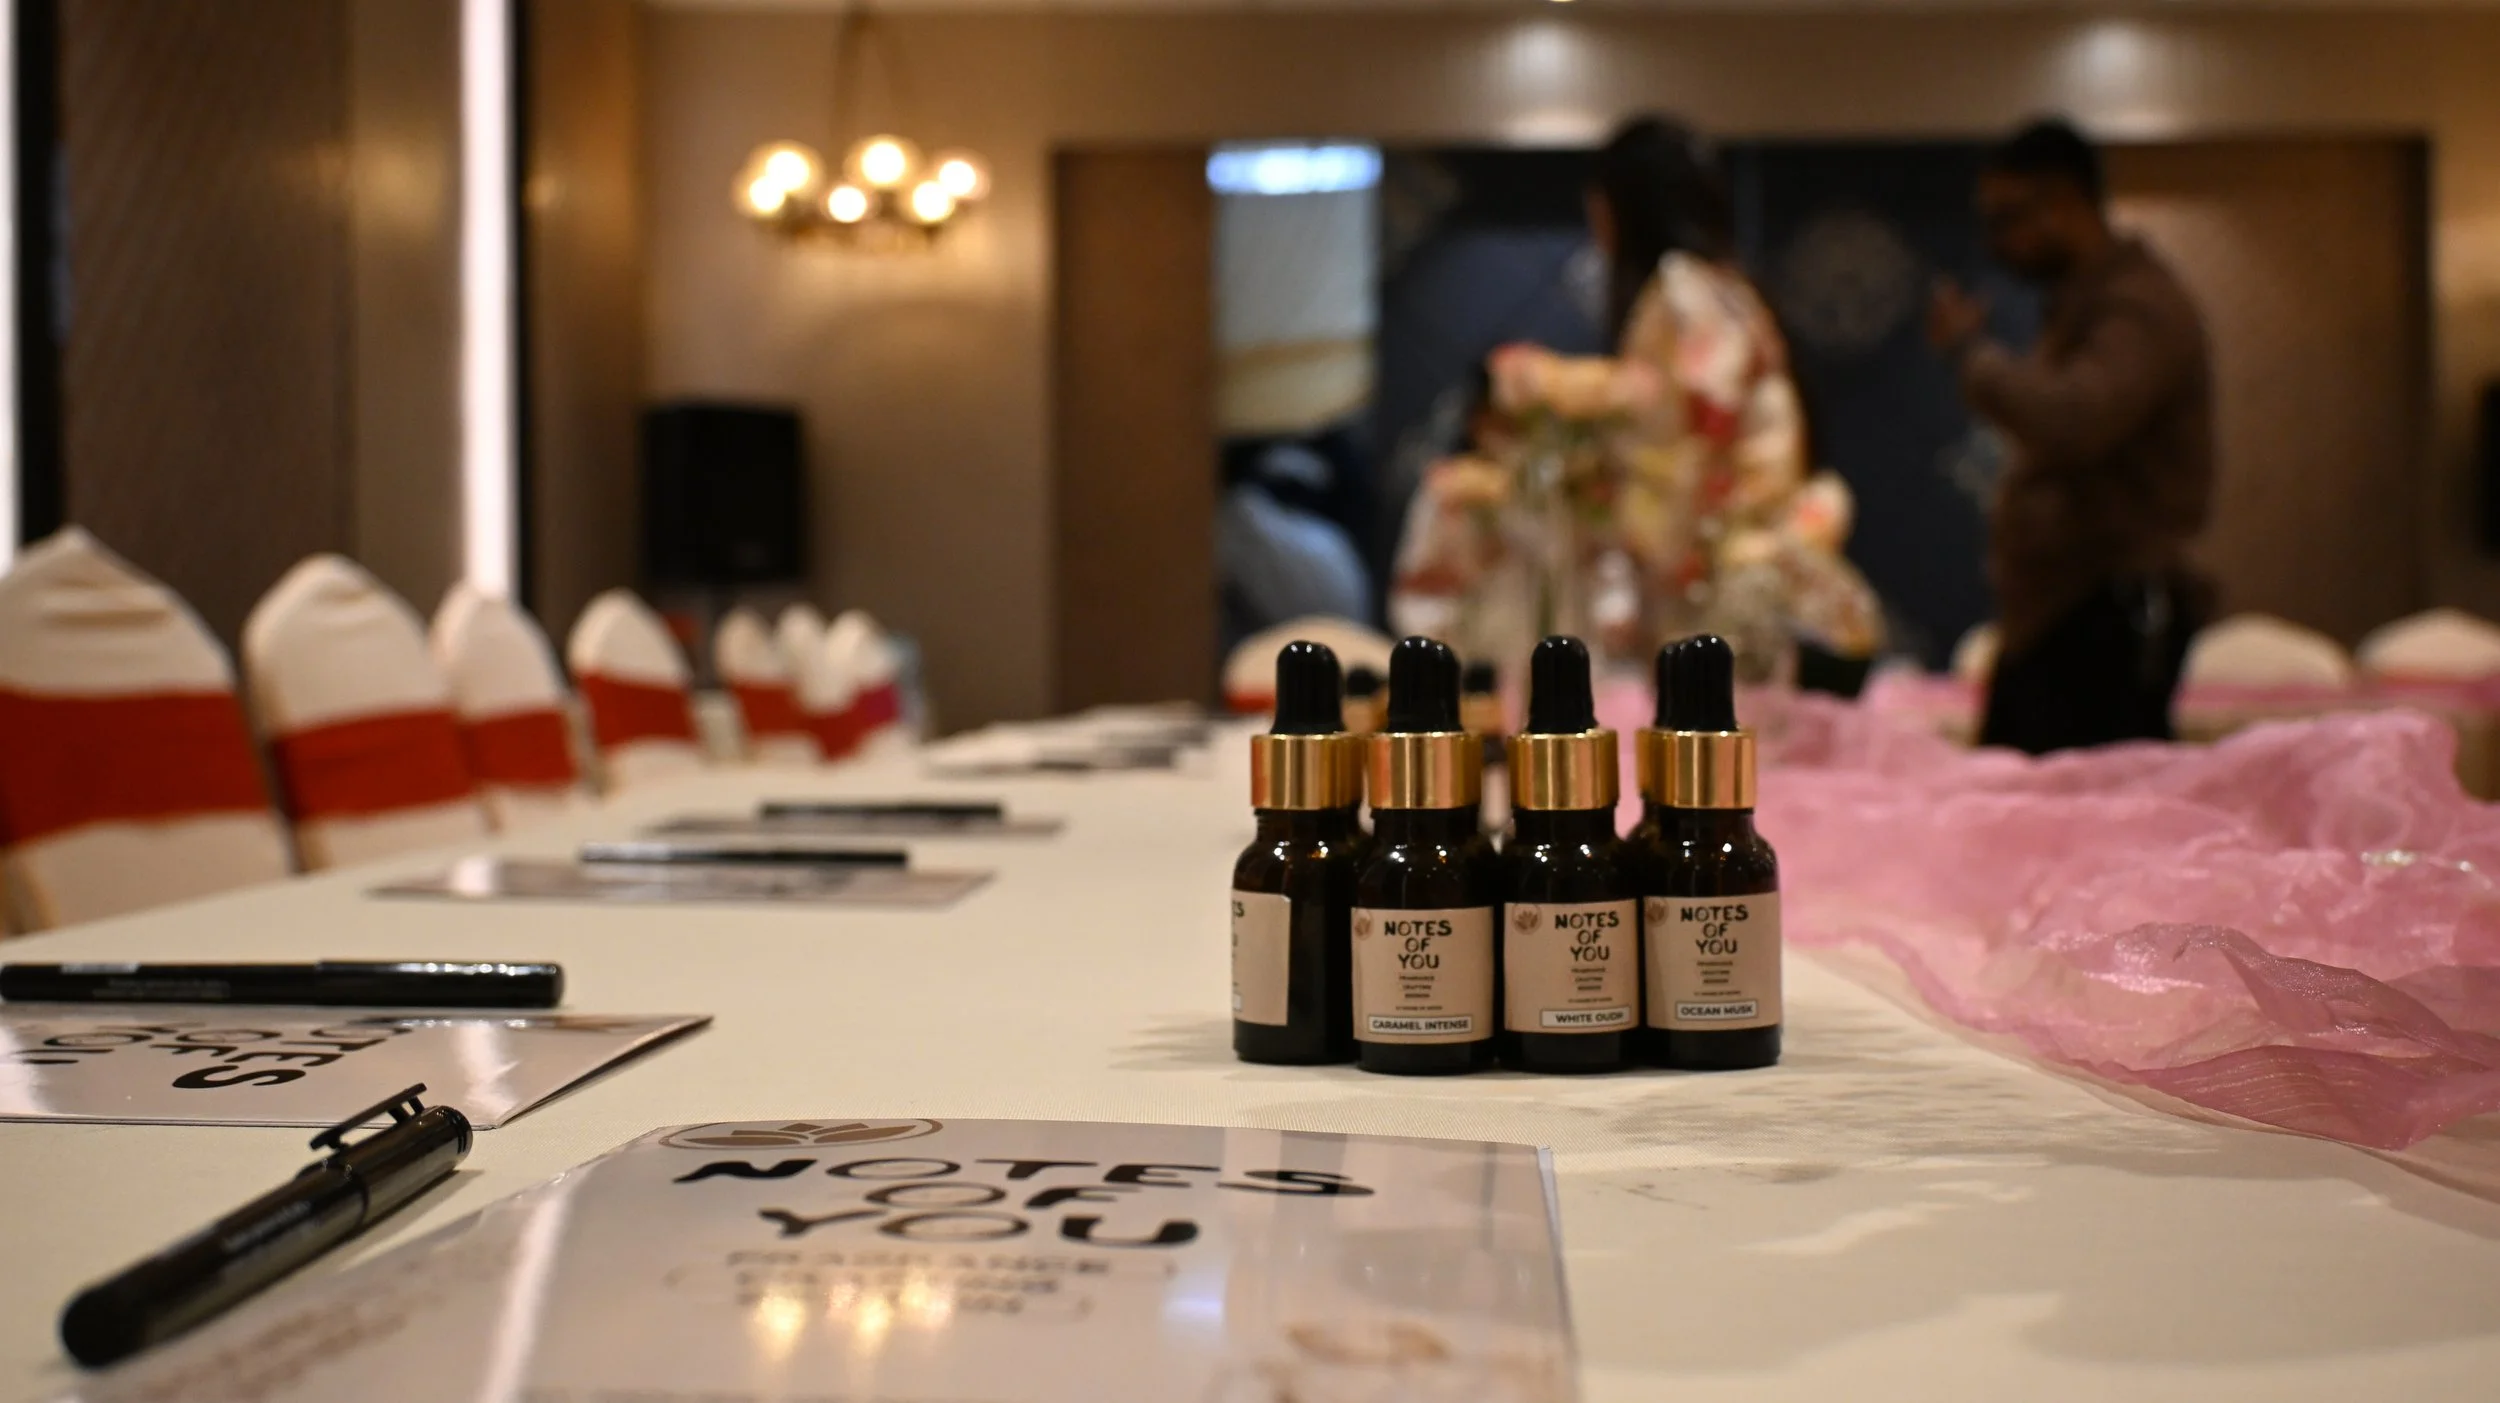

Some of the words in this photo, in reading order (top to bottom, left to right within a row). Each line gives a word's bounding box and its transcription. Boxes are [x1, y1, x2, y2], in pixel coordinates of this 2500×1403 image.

[1555, 911, 1619, 929] NOTES
[1680, 904, 1749, 922] NOTES
[1384, 919, 1452, 937] NOTES
[1703, 922, 1728, 938] OF
[1404, 937, 1431, 953] OF
[1577, 929, 1602, 945] OF
[1570, 945, 1610, 962] YOU
[1695, 939, 1738, 955] YOU
[1397, 953, 1440, 970] YOU
[1555, 1013, 1592, 1023] WHITE
[1681, 1005, 1721, 1016] OCEAN
[1723, 1003, 1753, 1015] MUSK
[1372, 1020, 1421, 1030] CARAMEL
[1425, 1020, 1469, 1031] INTENSE
[672, 1157, 1375, 1197] NOTES
[864, 1181, 1142, 1210] OF
[757, 1207, 1200, 1247] YOU
